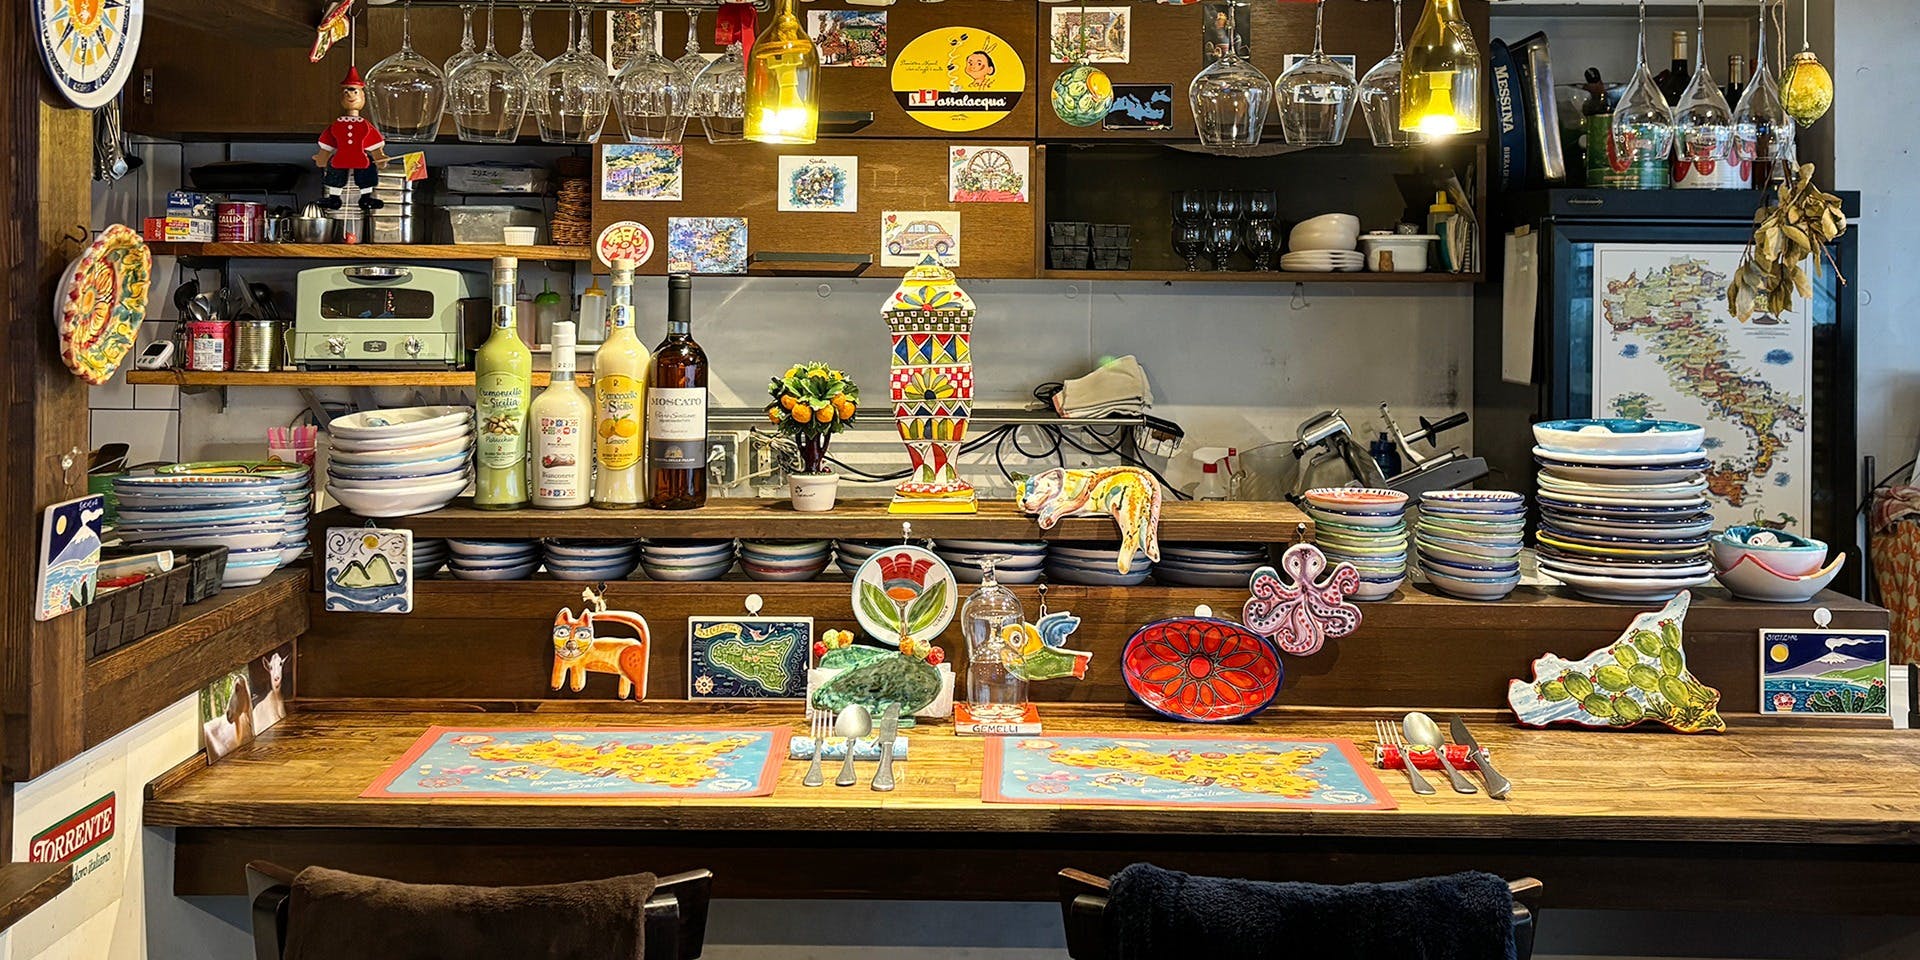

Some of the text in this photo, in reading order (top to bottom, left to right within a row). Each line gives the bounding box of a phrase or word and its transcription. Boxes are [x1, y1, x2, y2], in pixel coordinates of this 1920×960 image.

[918, 89, 1007, 111] Passalacqua
[1494, 65, 1514, 134] MESSINA
[490, 397, 518, 408] Sicilia
[651, 397, 702, 406] MOSCATO
[972, 724, 1018, 733] GEMELLI
[33, 807, 112, 862] TORRENTE
